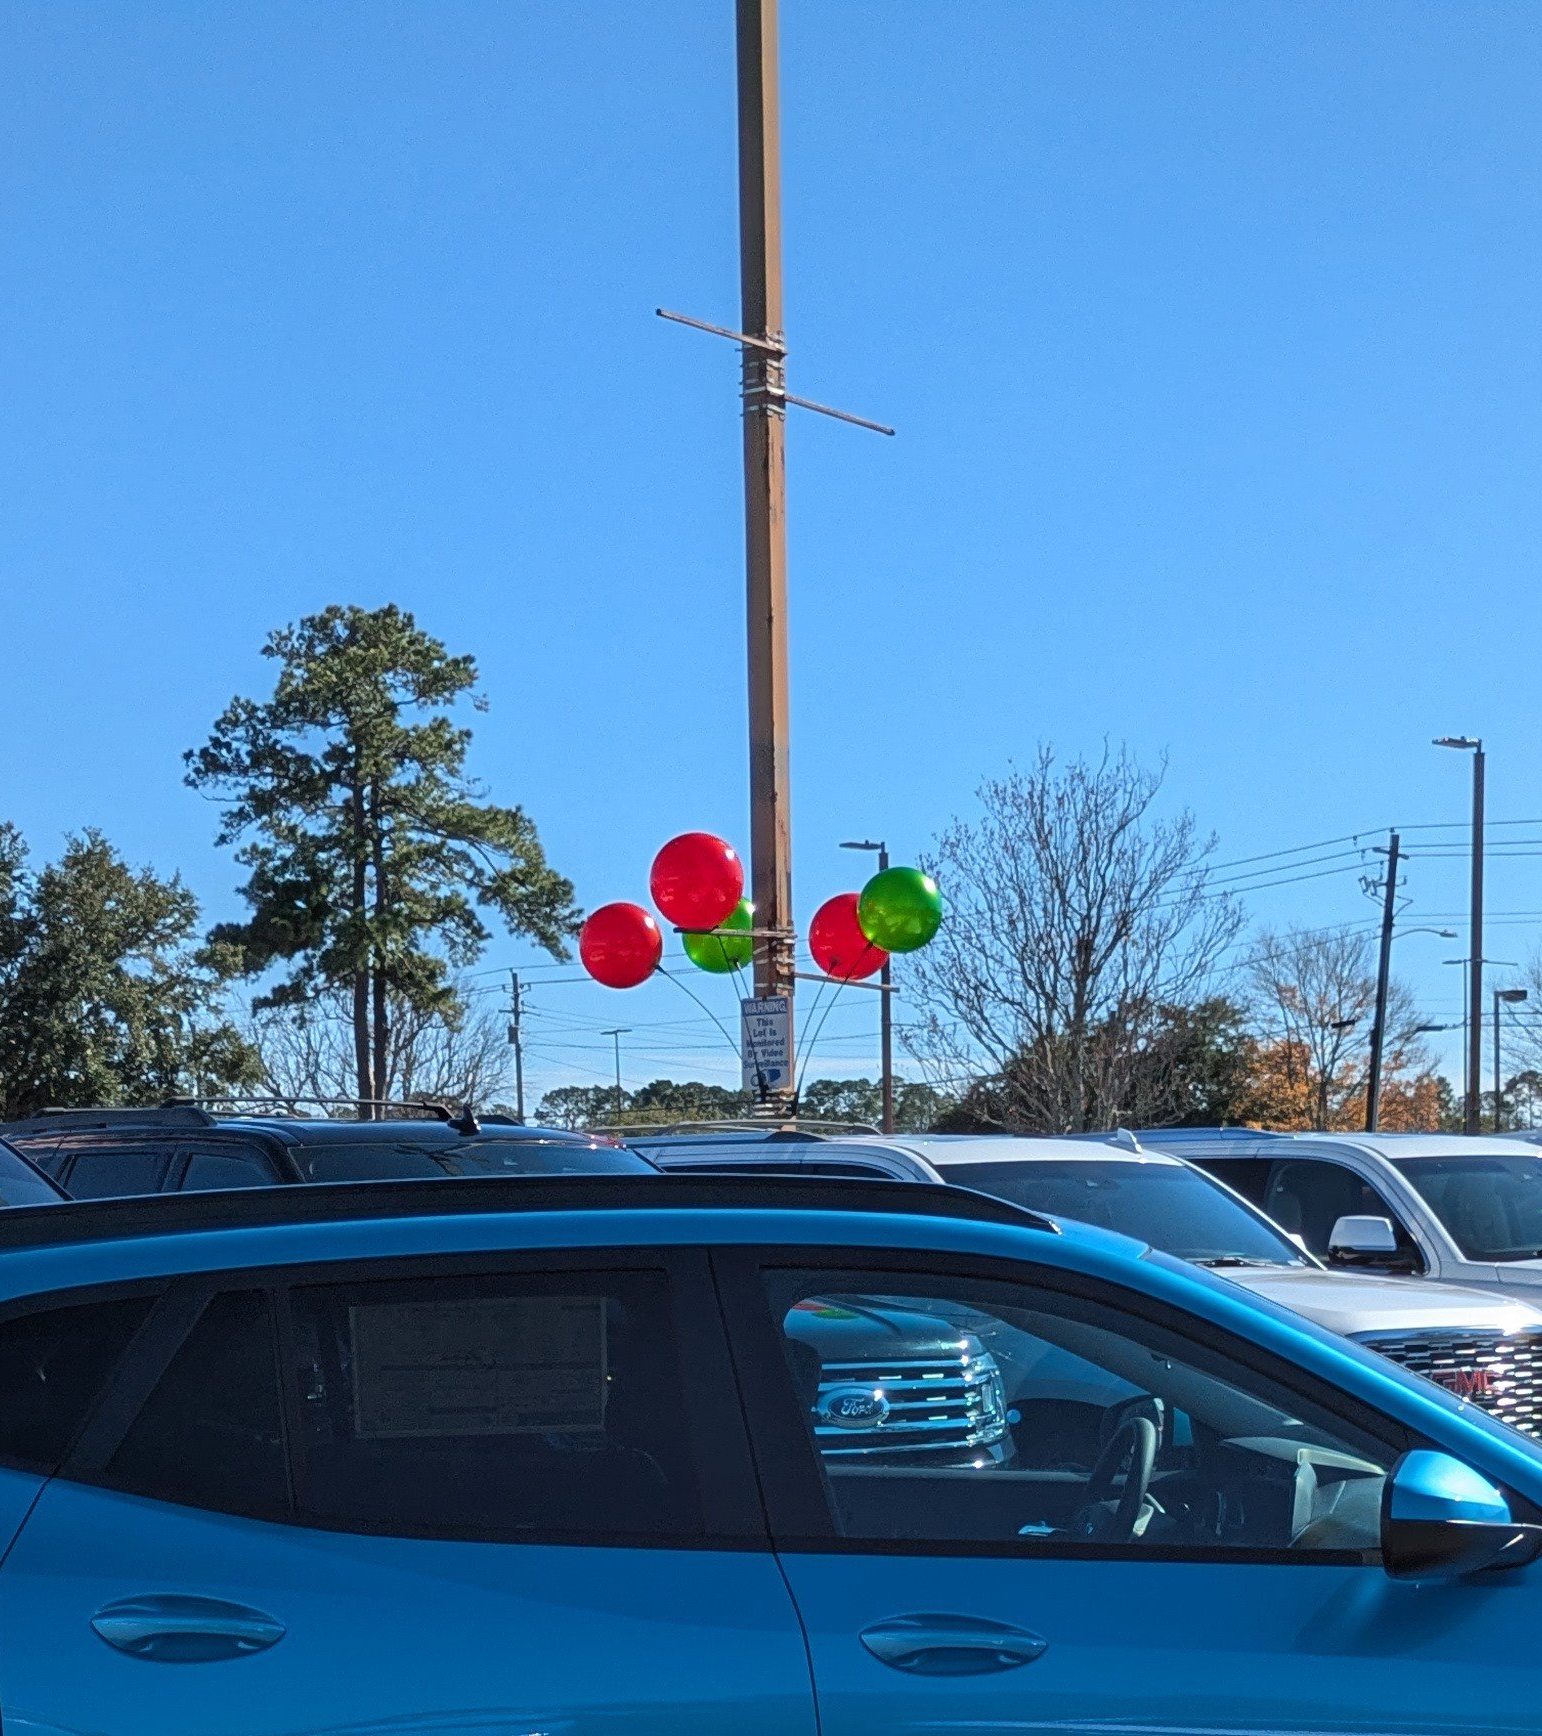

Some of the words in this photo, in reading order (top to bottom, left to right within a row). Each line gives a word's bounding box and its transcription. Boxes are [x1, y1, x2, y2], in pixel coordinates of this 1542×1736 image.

[756, 1018, 774, 1027] This
[761, 1048, 784, 1057] Video
[841, 1398, 874, 1416] Ford
